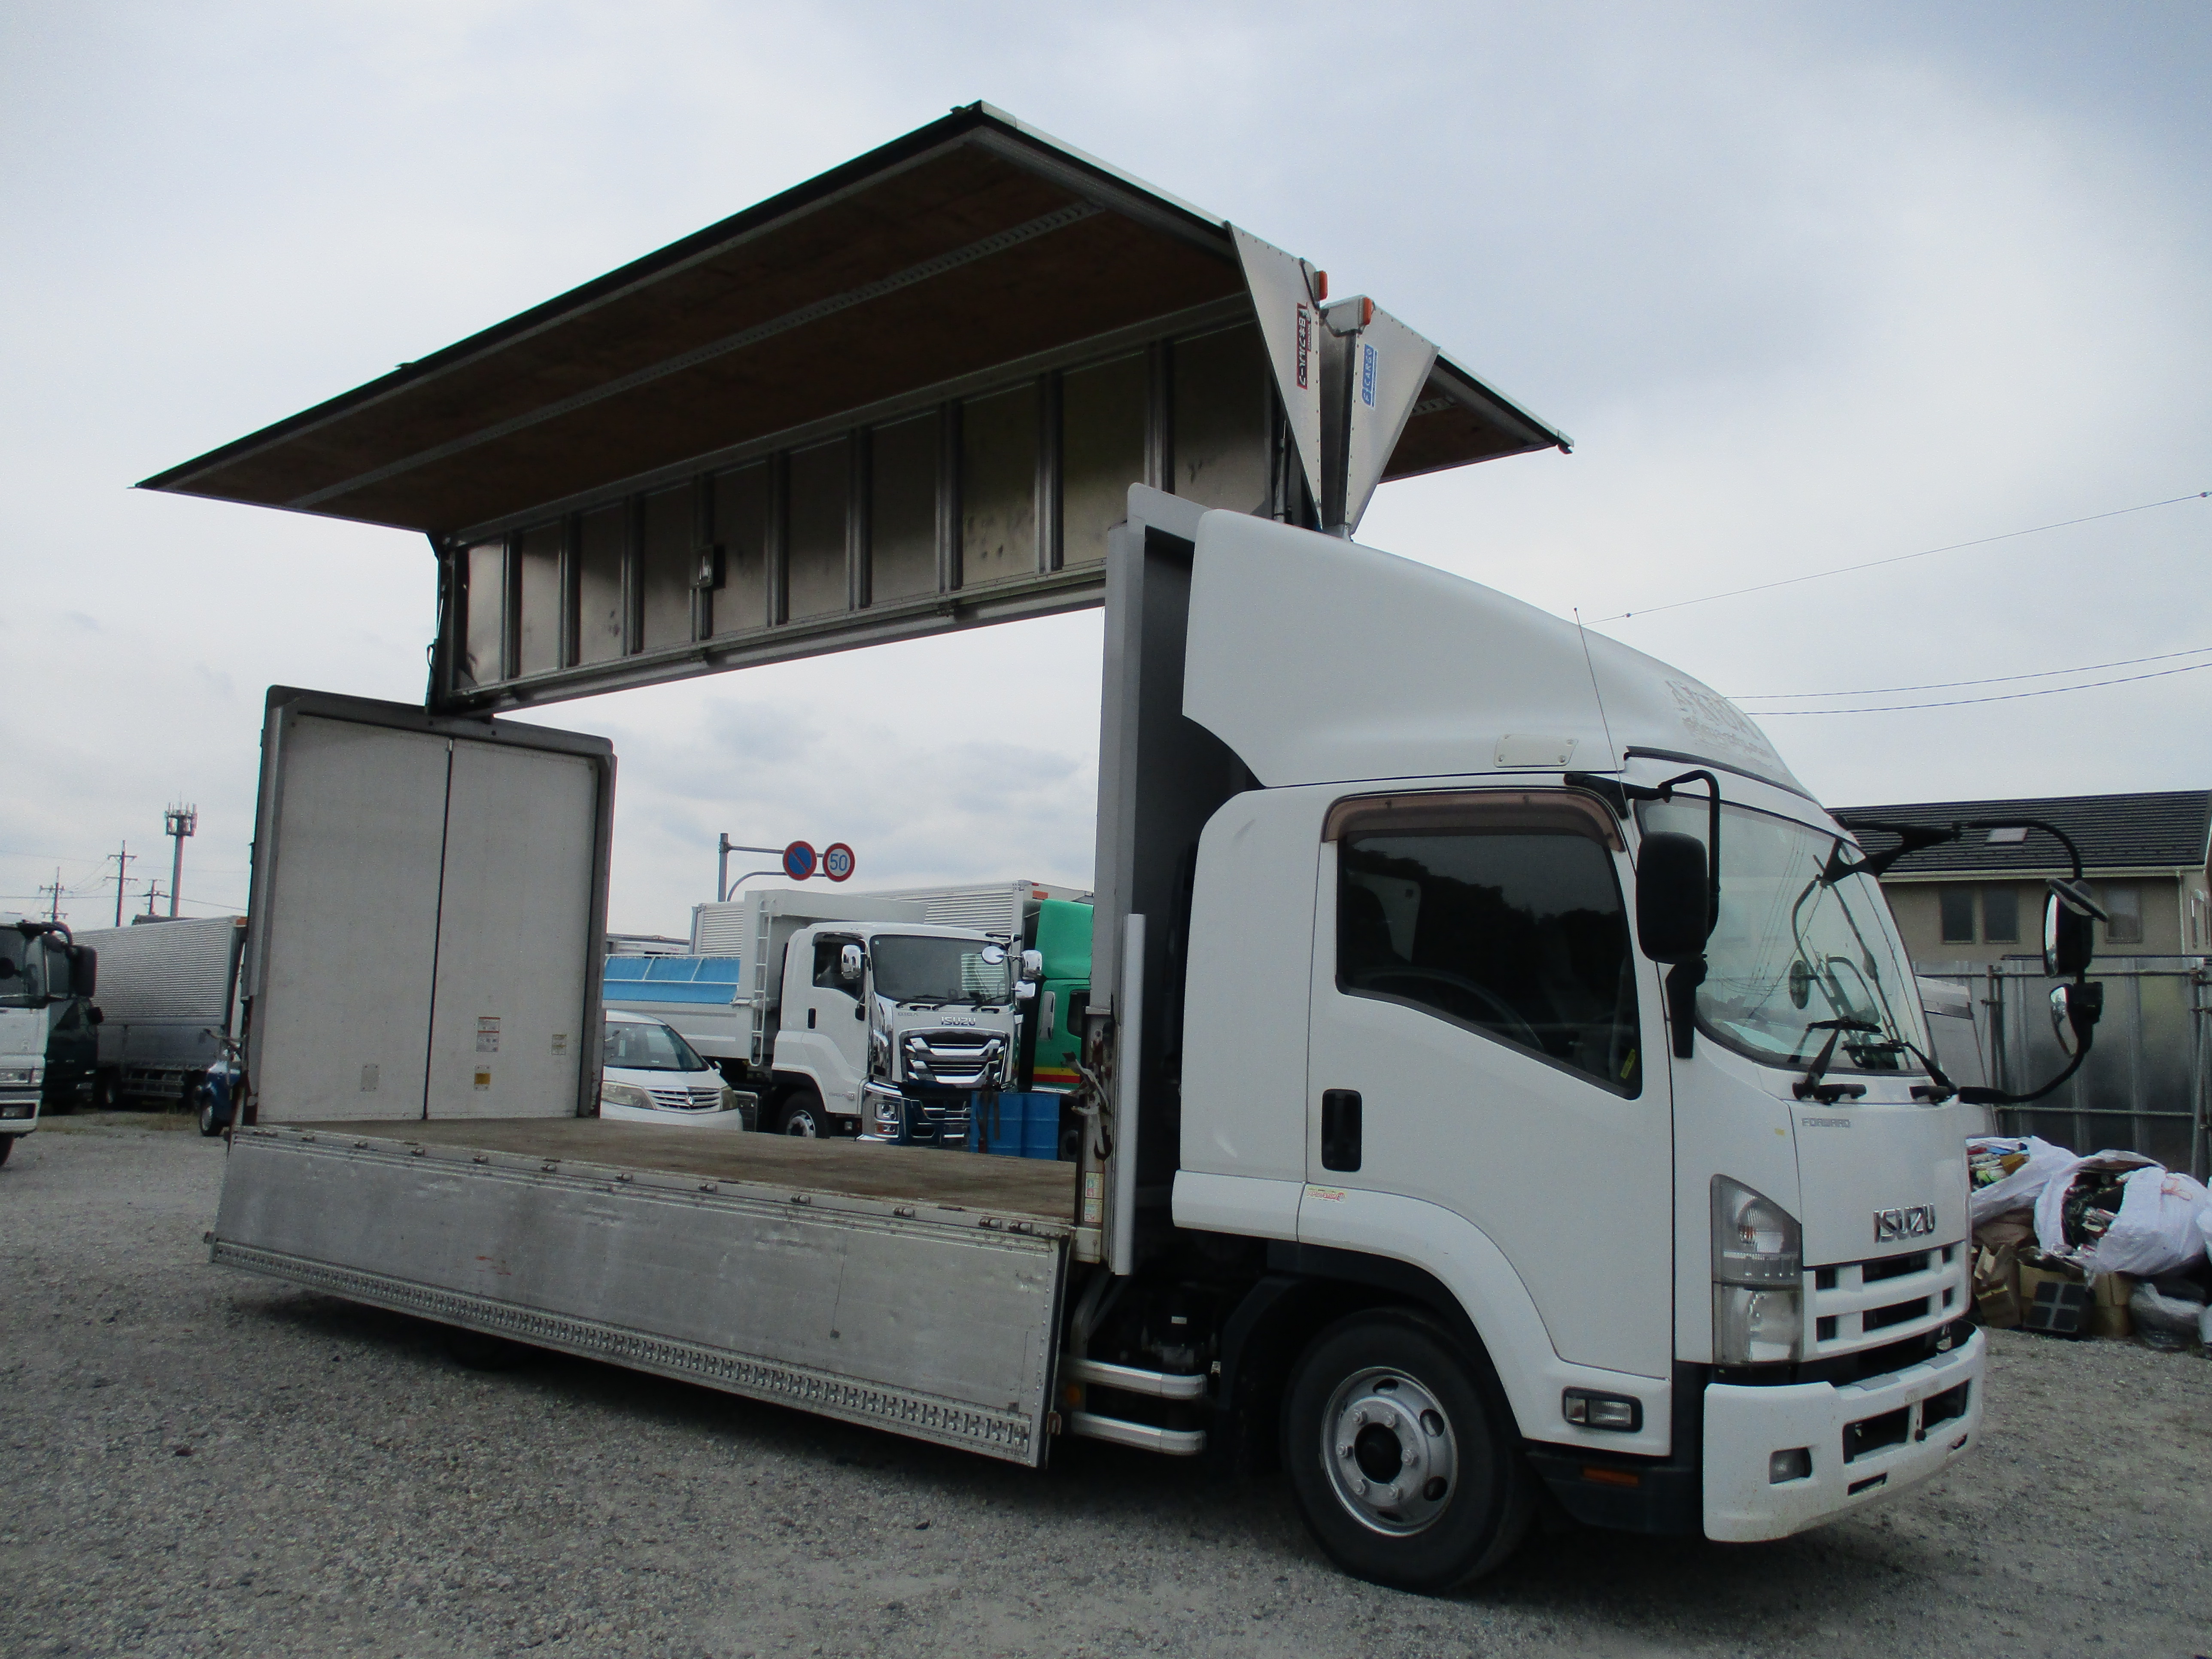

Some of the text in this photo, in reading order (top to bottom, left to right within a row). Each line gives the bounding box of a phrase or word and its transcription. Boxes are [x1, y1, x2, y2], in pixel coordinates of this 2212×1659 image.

[1364, 349, 1372, 386] CARGO
[830, 854, 848, 872] 50
[941, 1016, 975, 1026] ISUZU
[1801, 1118, 1852, 1128] FORWARD
[1873, 1203, 1936, 1244] ISUZU
